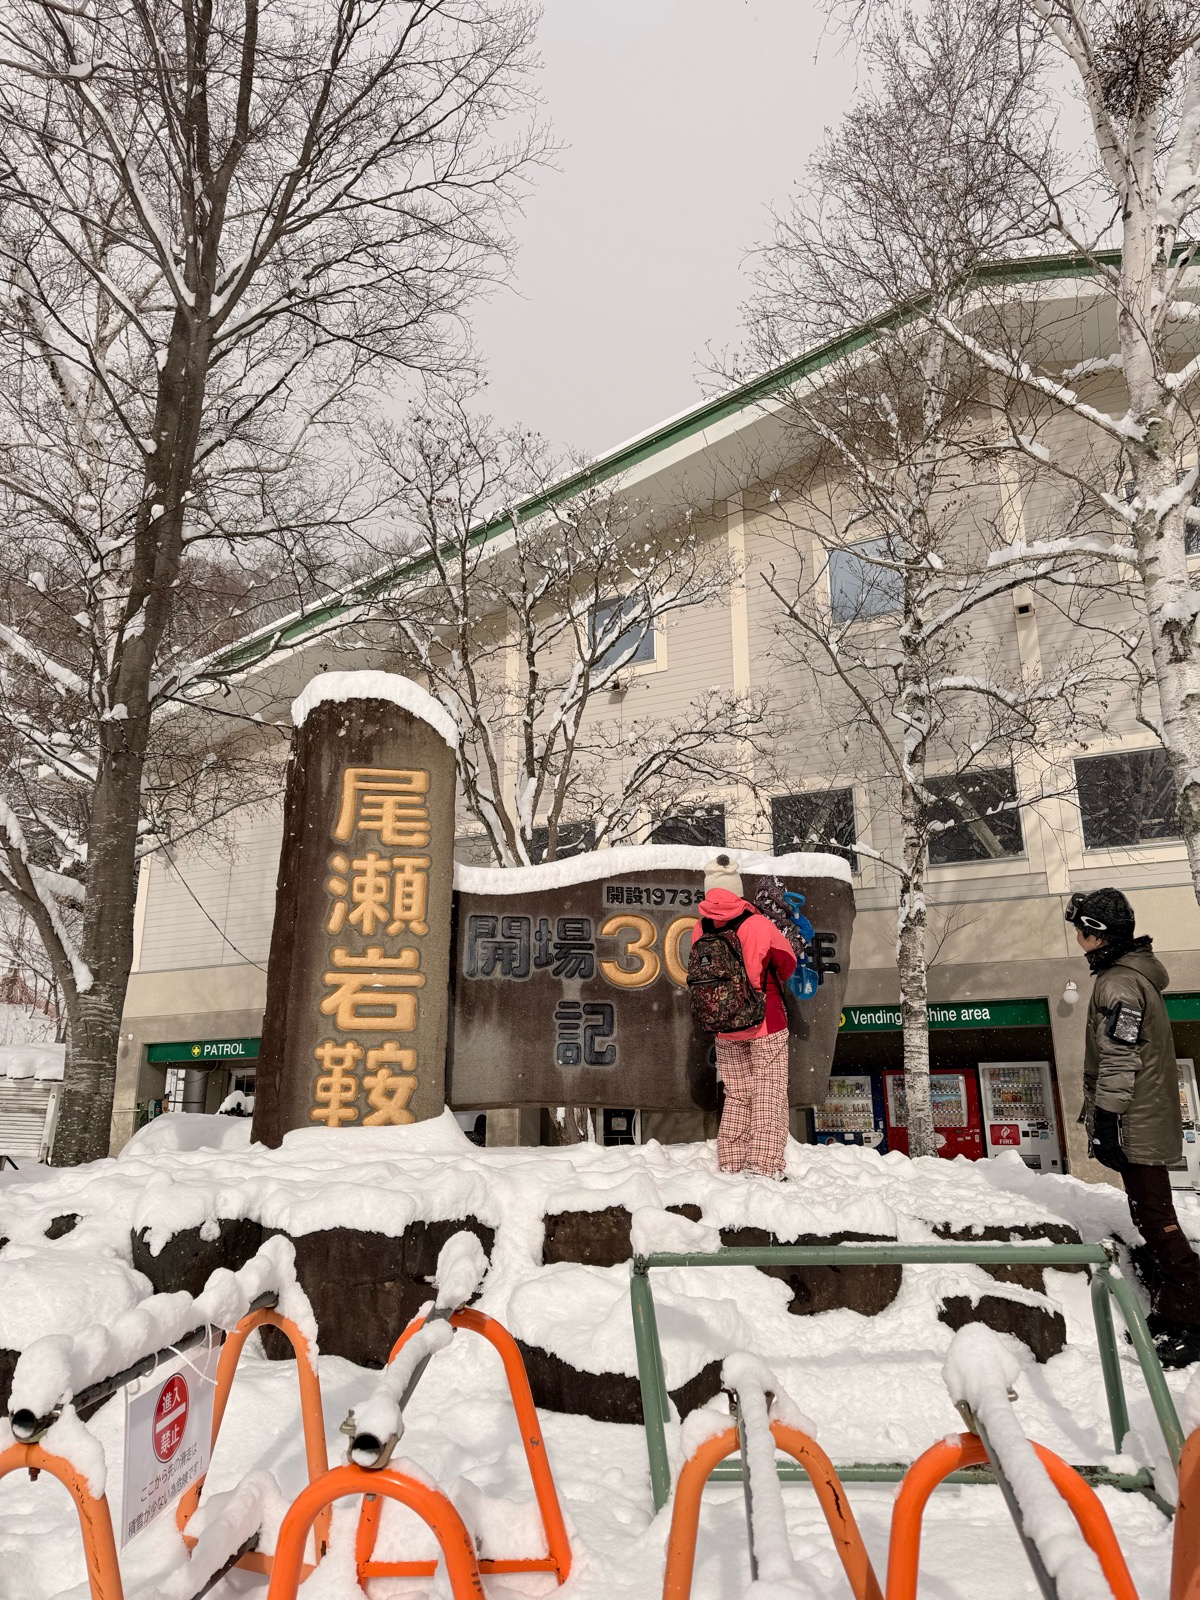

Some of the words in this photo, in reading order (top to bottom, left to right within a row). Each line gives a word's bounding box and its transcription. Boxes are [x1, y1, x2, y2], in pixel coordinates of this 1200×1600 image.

[310, 766, 431, 1128] 尾瀬岩鞍
[850, 1009, 903, 1026] Vending
[960, 1007, 991, 1021] area
[203, 1043, 246, 1056] PATROL
[162, 1386, 181, 1416] 進入
[160, 1423, 180, 1454] 禁止
